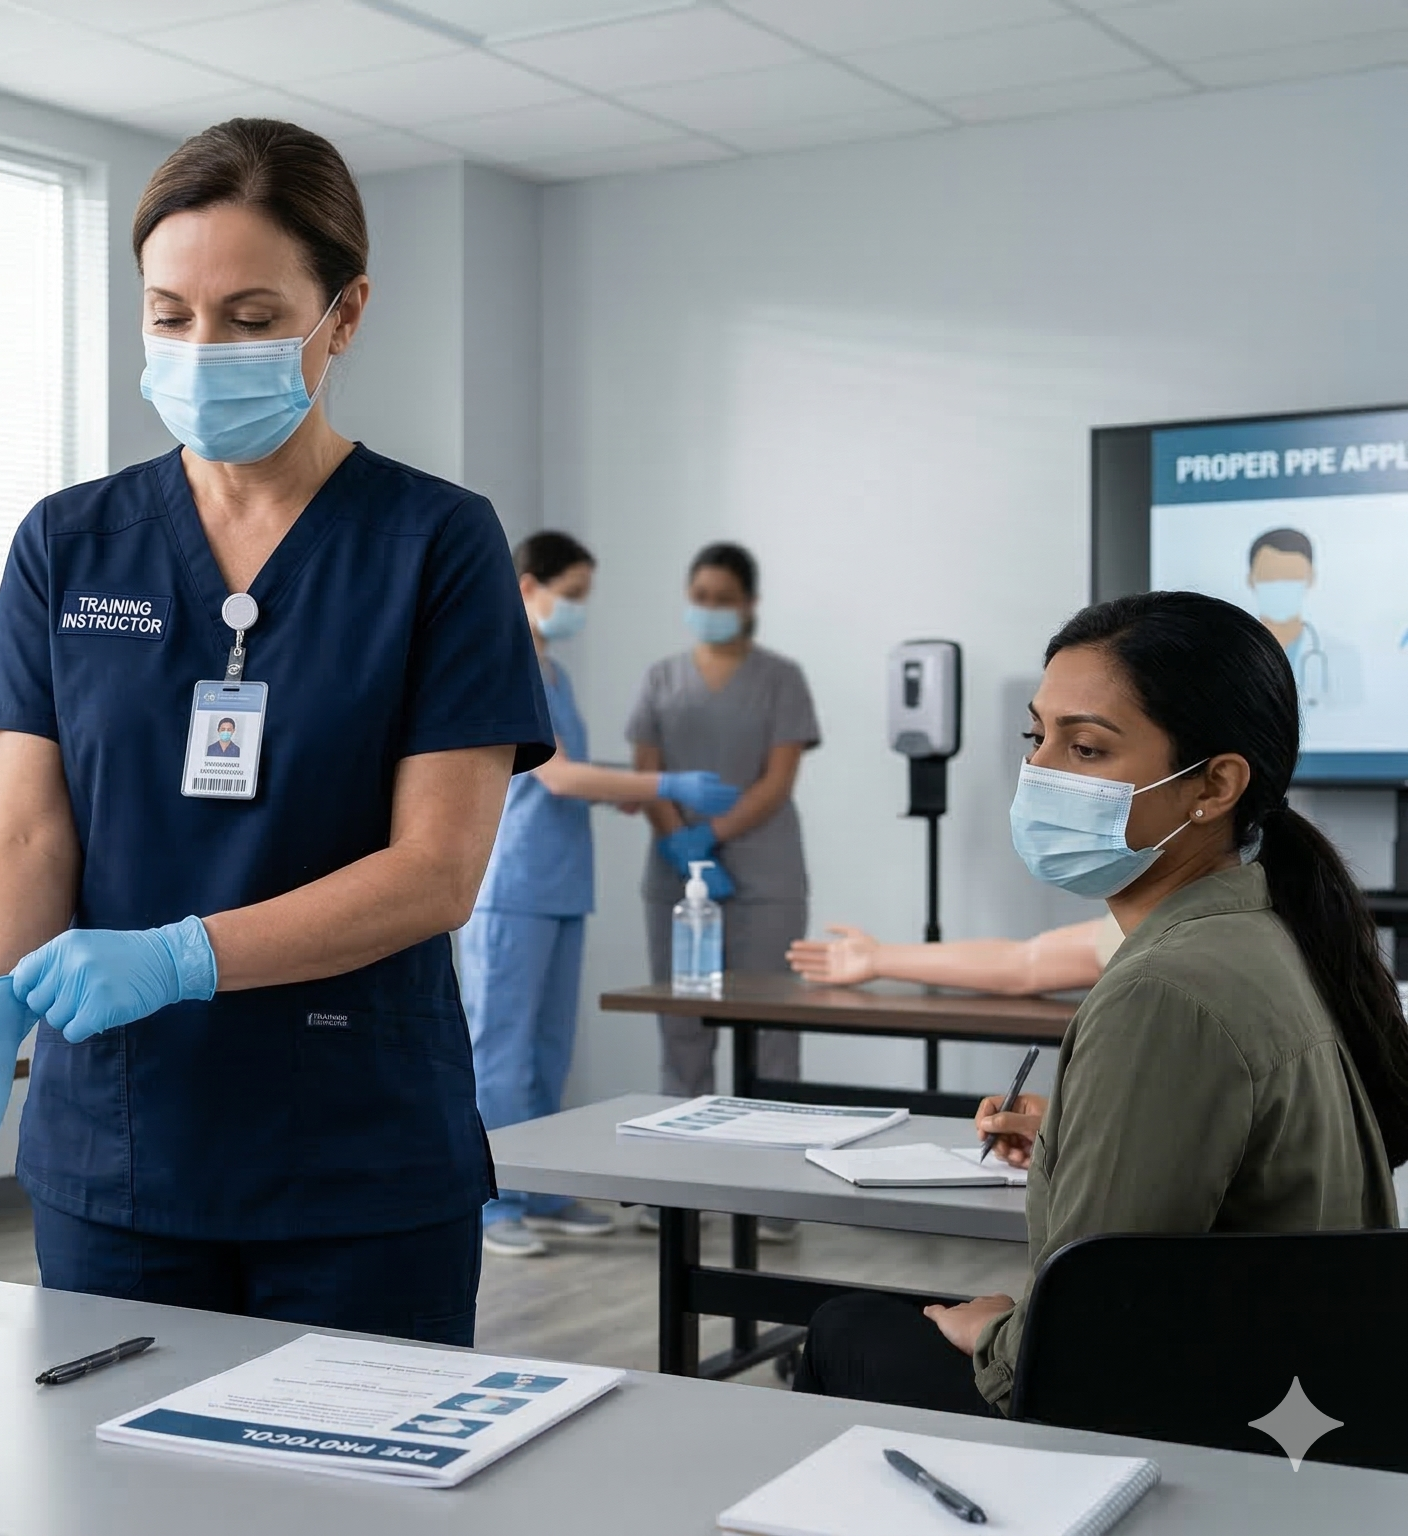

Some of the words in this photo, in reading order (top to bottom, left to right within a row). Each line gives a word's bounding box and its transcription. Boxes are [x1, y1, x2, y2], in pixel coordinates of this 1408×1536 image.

[1176, 451, 1279, 483] PROPER
[1284, 447, 1336, 477] PPE
[78, 597, 152, 616] TRAINING
[62, 613, 162, 634] INSTRUCTOR
[242, 1428, 376, 1454] PROTOCOL
[379, 1441, 438, 1461] PPE
